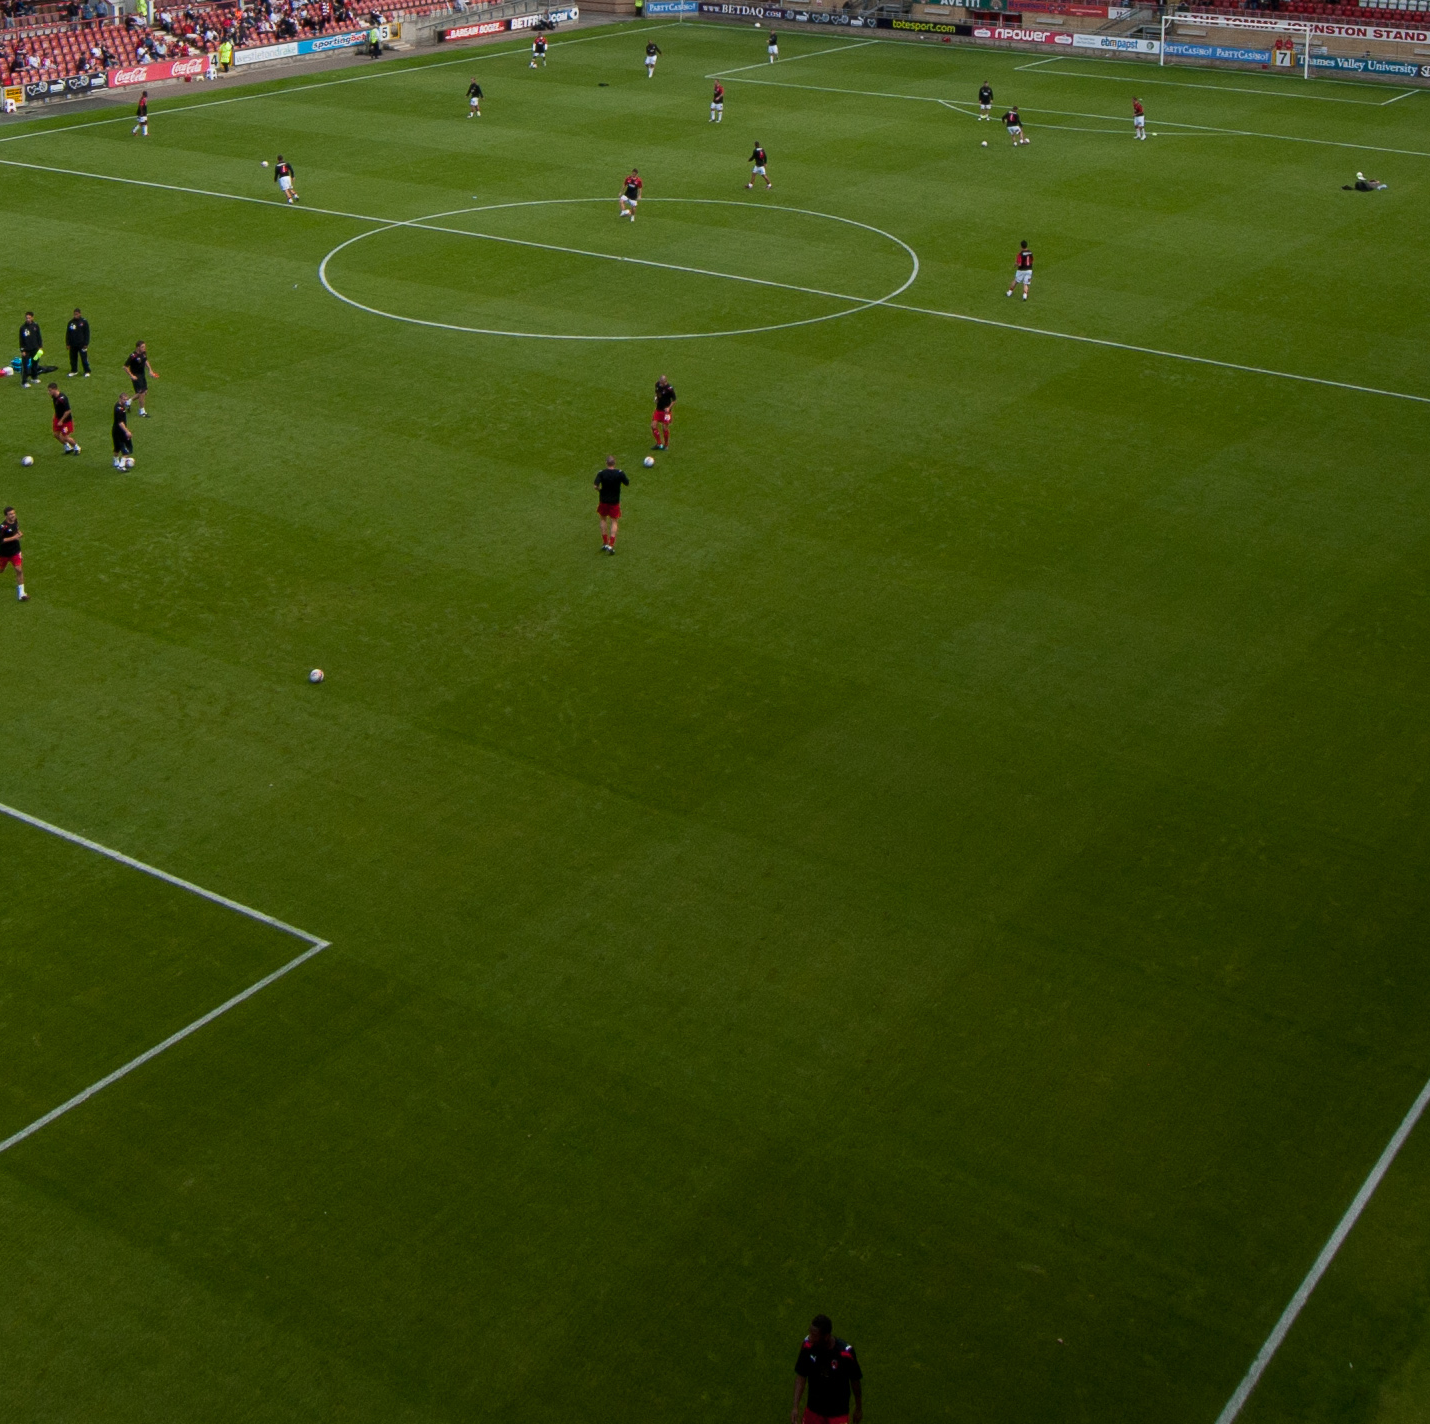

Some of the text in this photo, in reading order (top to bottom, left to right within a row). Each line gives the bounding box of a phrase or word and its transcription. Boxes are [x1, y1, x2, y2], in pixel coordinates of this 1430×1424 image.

[721, 4, 764, 18] BETDAQ
[892, 19, 956, 34] totesport.com
[1373, 29, 1427, 42] STAND
[210, 54, 218, 67] 4
[1278, 52, 1288, 65] 7
[1297, 54, 1418, 76] Tames Valley University
